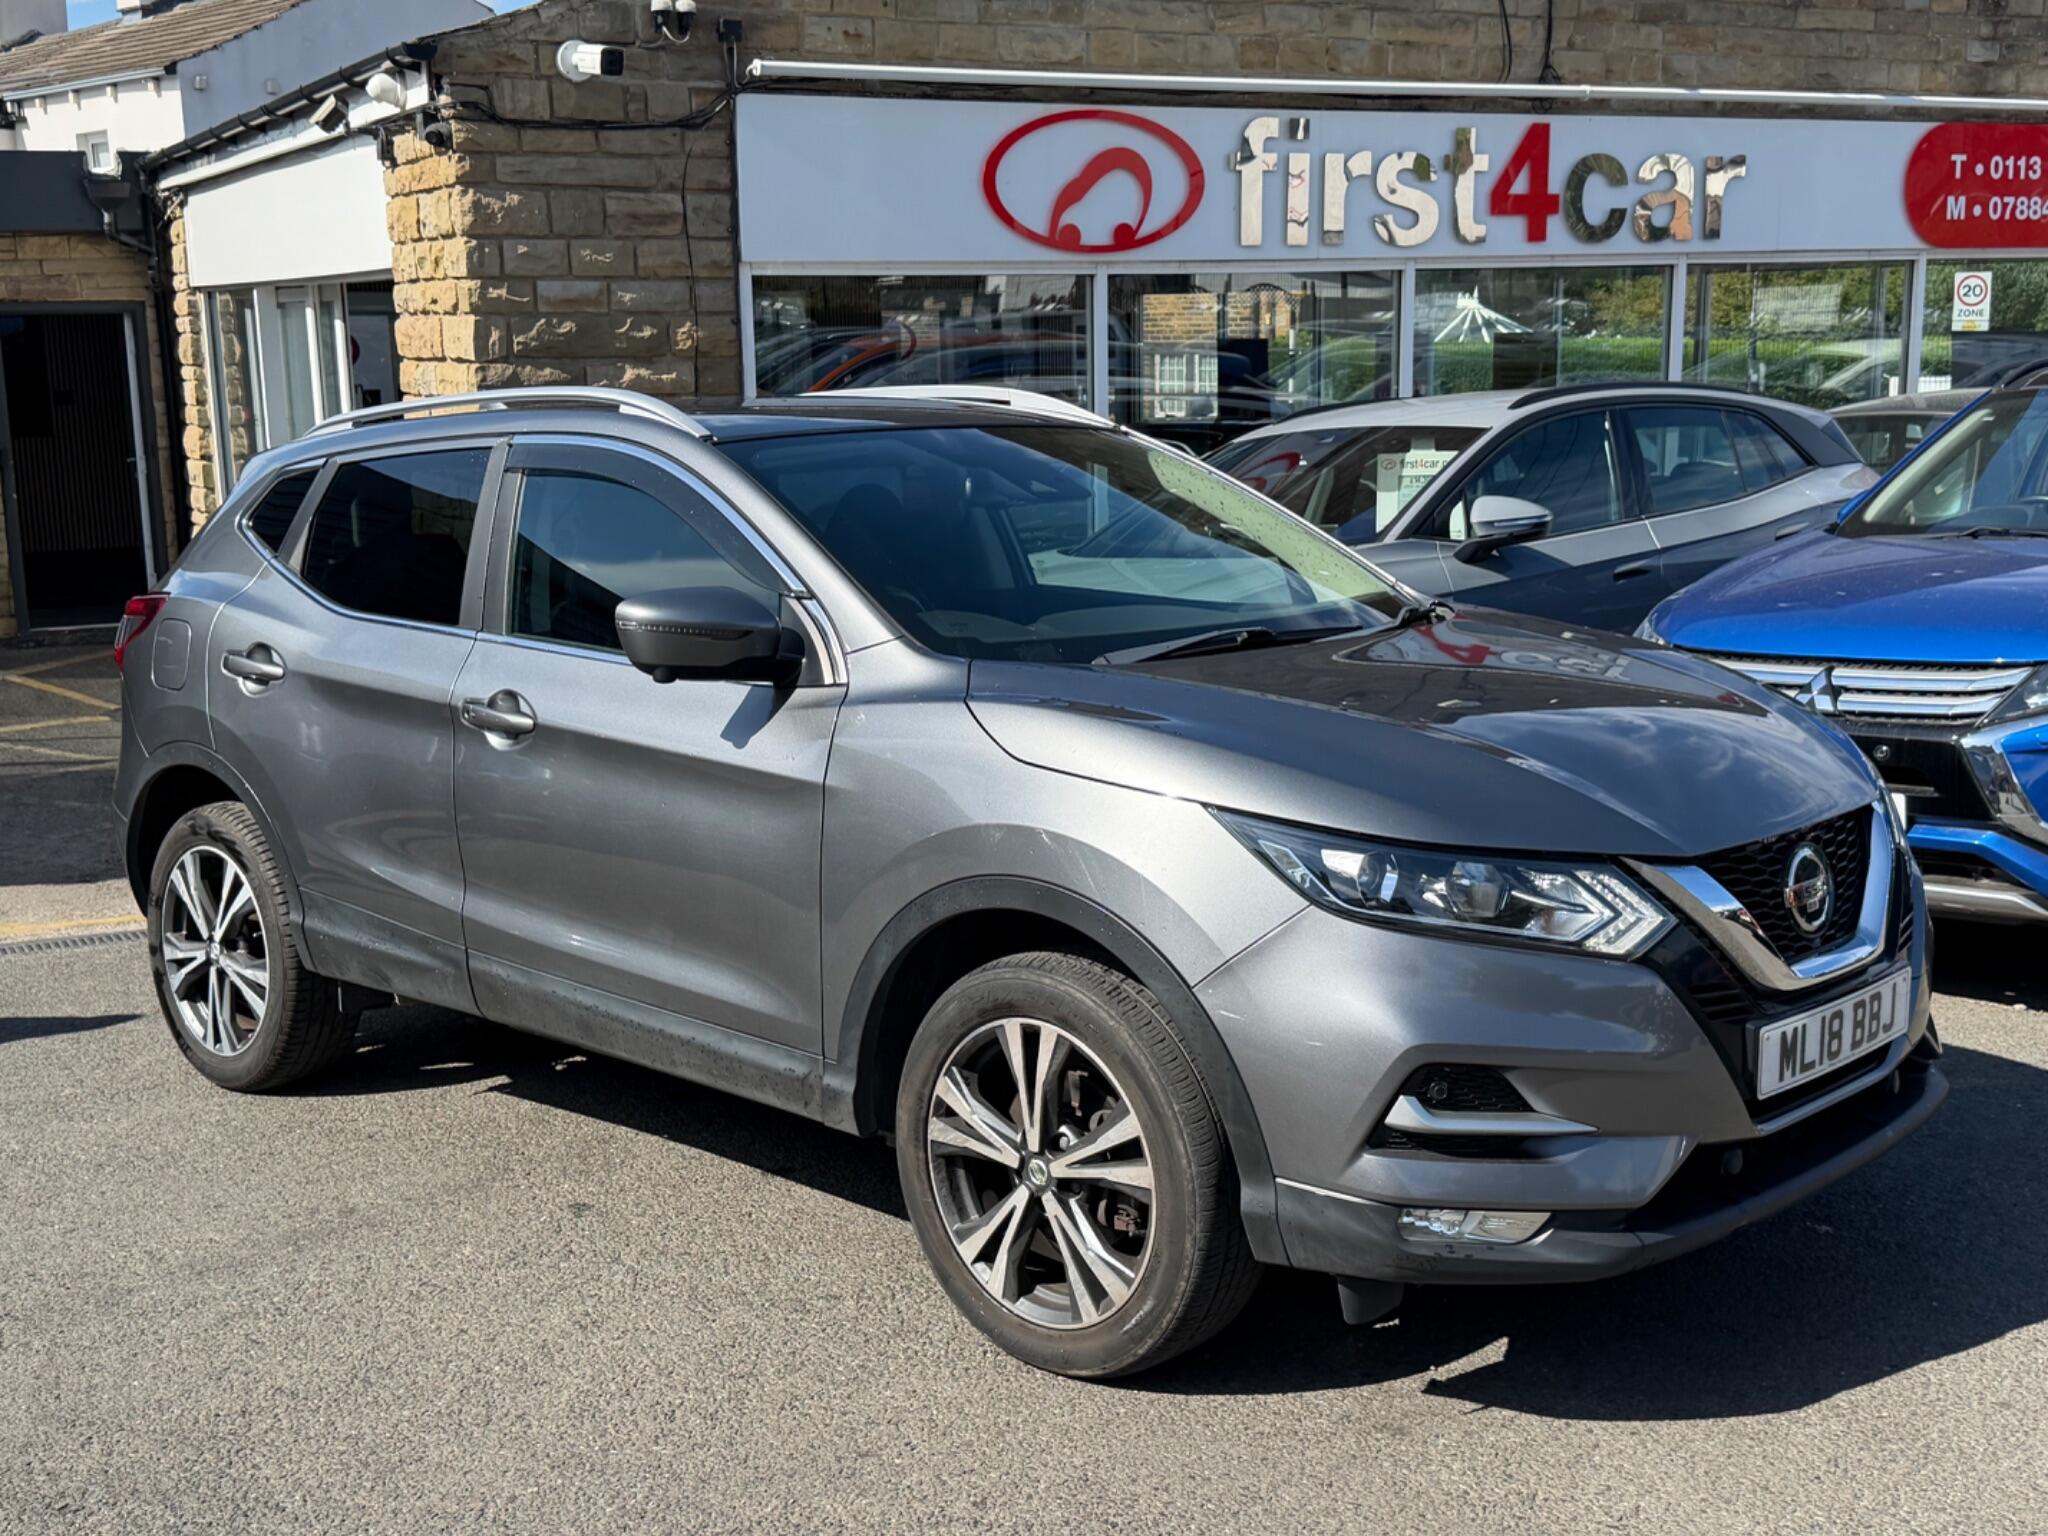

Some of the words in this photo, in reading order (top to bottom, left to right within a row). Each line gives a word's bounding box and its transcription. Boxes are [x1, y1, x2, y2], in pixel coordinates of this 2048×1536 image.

[1990, 155, 2042, 180] 0113
[1229, 117, 1747, 247] first4car
[1962, 284, 1984, 298] 20
[1957, 308, 1985, 318] ZONE
[1778, 1008, 1844, 1083] ML18
[1851, 982, 1897, 1051] BBJ
